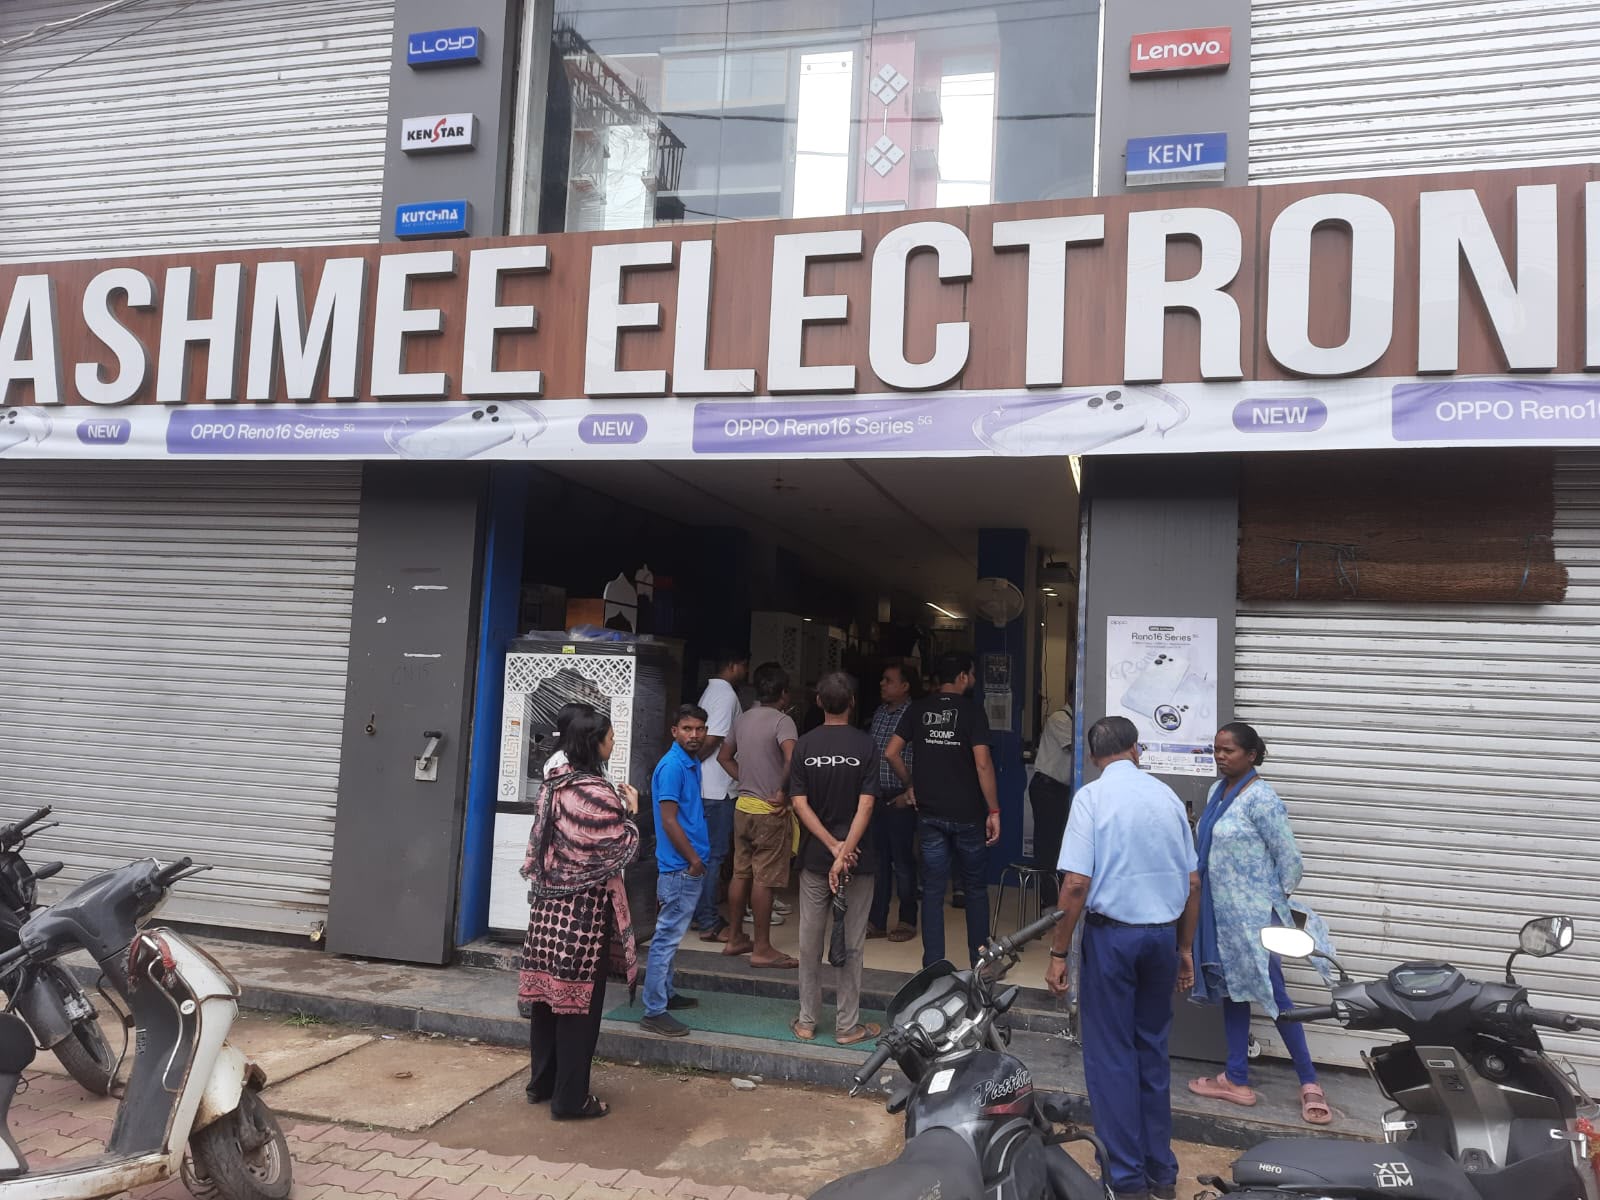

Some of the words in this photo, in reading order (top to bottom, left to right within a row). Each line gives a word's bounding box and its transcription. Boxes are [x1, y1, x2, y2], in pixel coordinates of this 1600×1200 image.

[409, 35, 475, 54] LLOYD
[1137, 40, 1221, 61] Lenovo
[407, 117, 464, 143] KENSTAR
[1148, 143, 1205, 164] KENT
[0, 244, 550, 404] ASHMEE
[1252, 406, 1309, 425] NEW
[1436, 400, 1514, 422] OPPO
[1520, 399, 1600, 421] Reno1
[87, 424, 121, 439] NEW
[191, 423, 234, 440] OPPO
[237, 423, 291, 439] Reno16
[293, 423, 340, 439] Series
[592, 421, 634, 437] NEW
[724, 418, 778, 437] OPPO
[783, 417, 851, 436] Reno16
[855, 416, 915, 435] Series
[917, 415, 932, 426] 5G
[1131, 632, 1163, 641] Reno16
[1164, 633, 1192, 642] Series
[929, 729, 955, 739] 200MP
